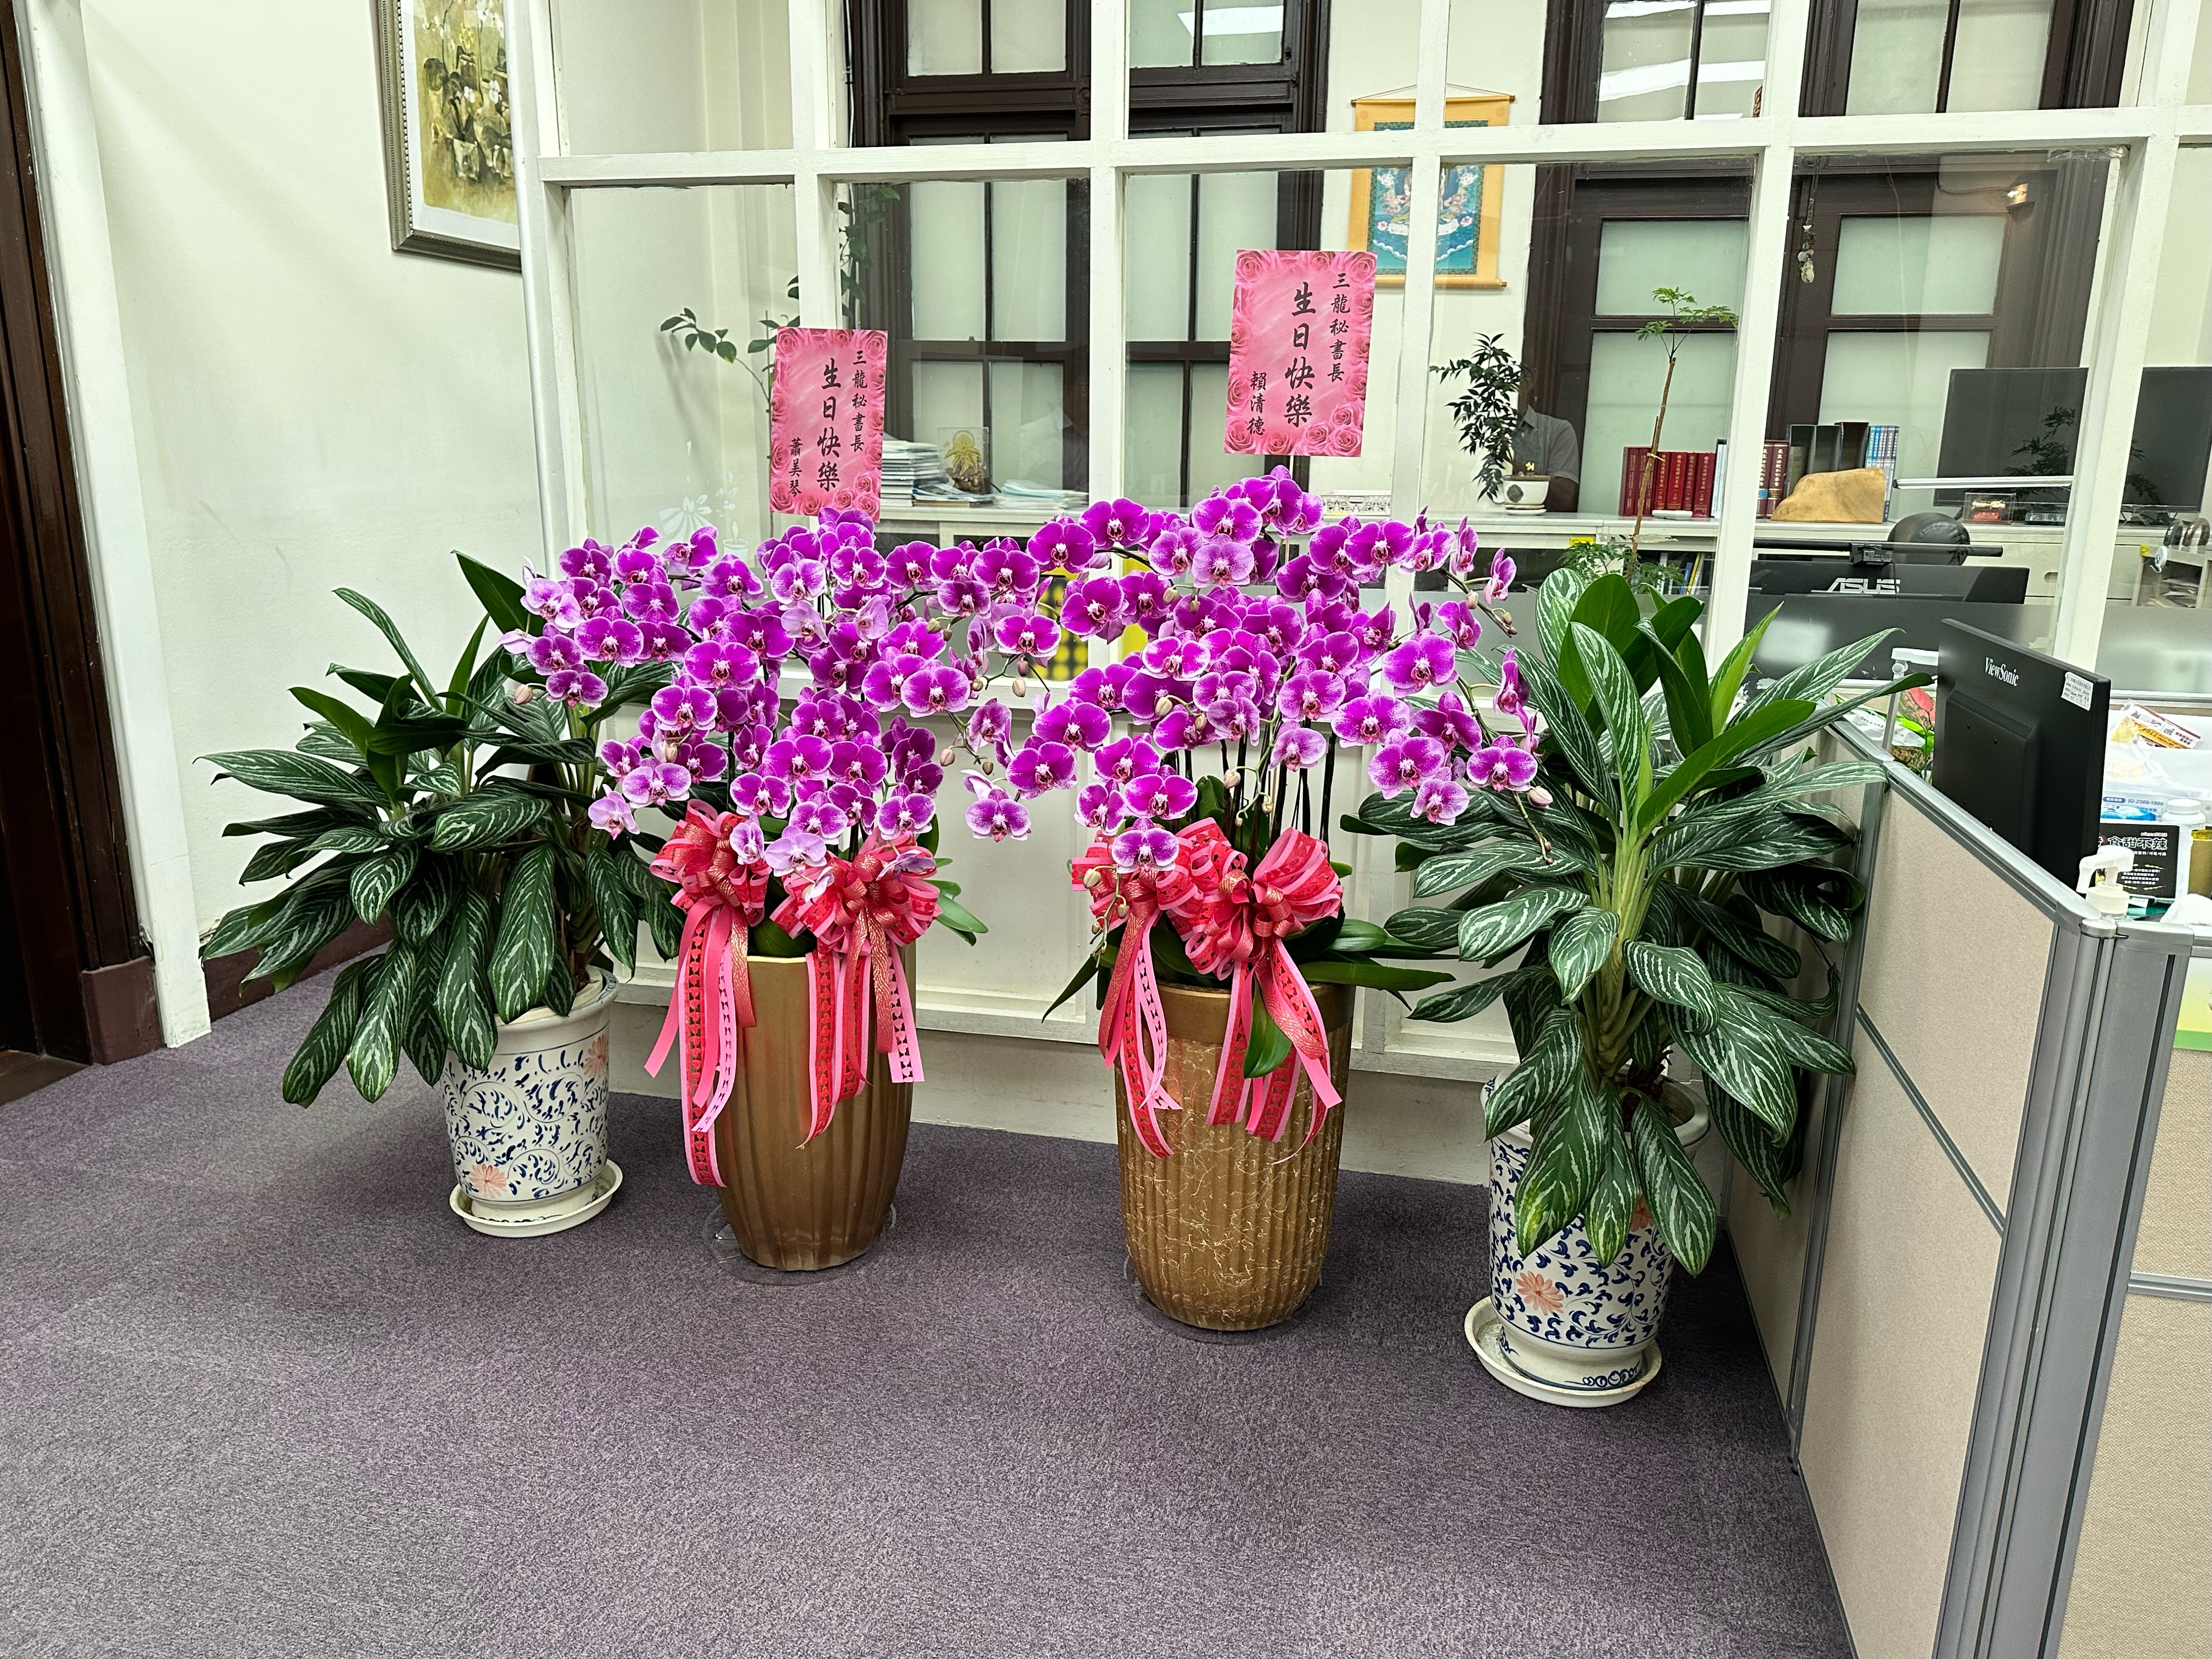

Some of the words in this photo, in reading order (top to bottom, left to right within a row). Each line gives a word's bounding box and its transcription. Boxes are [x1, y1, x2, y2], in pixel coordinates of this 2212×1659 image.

[1284, 281, 1316, 428] 生日快樂
[1327, 273, 1350, 382] 三龍秘書長
[816, 358, 841, 492] 生日快樂
[850, 350, 868, 452] 三龍秘書長
[1247, 371, 1267, 436] 賴清德
[788, 438, 803, 497] 蕭美琴
[1826, 578, 1900, 594] ASUS
[1984, 657, 2019, 686] ViewSonic
